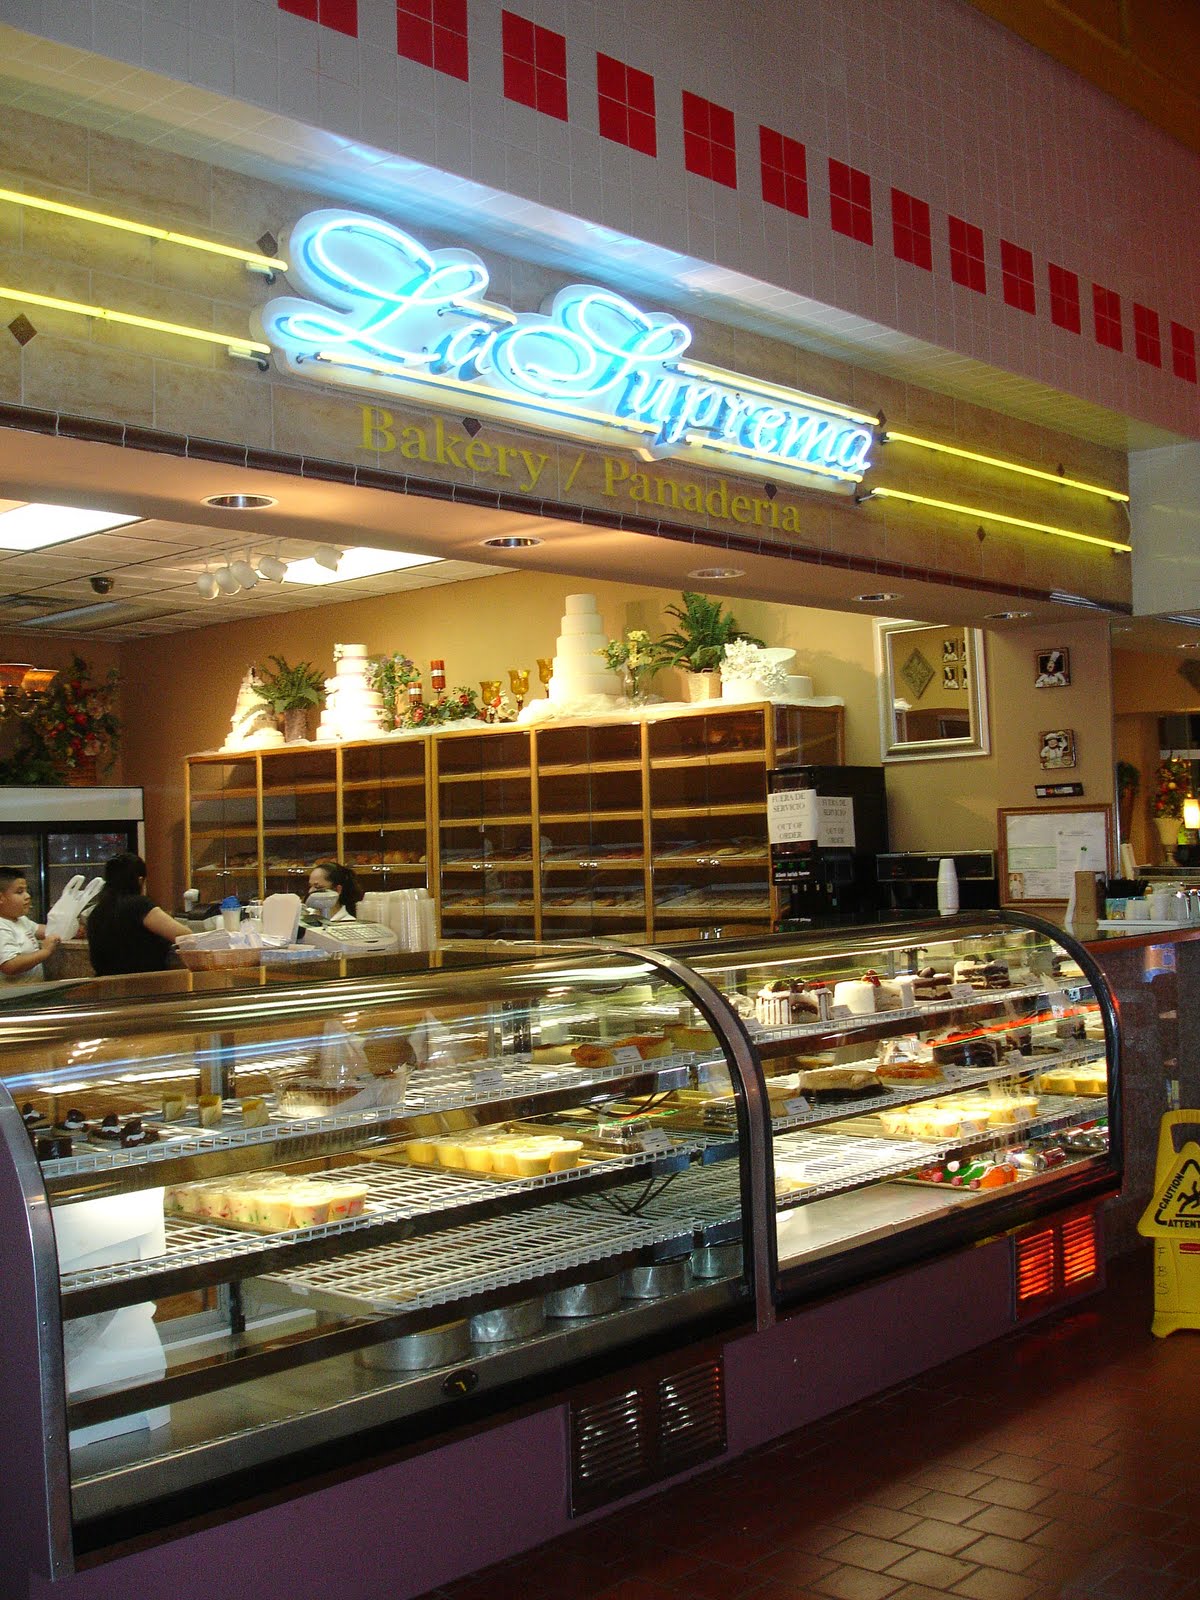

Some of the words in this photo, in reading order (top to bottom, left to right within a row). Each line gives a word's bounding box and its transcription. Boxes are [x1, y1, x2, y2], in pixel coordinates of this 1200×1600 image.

[276, 213, 498, 384] La
[494, 287, 873, 472] Suprema
[355, 403, 550, 492] Bakery
[602, 456, 801, 533] Panaderia
[794, 792, 806, 800] DE
[772, 803, 806, 813] SERVICIO
[777, 822, 792, 831] OUT
[793, 821, 803, 829] OF
[779, 831, 802, 840] ORDER
[1159, 1172, 1185, 1210] CAUTION
